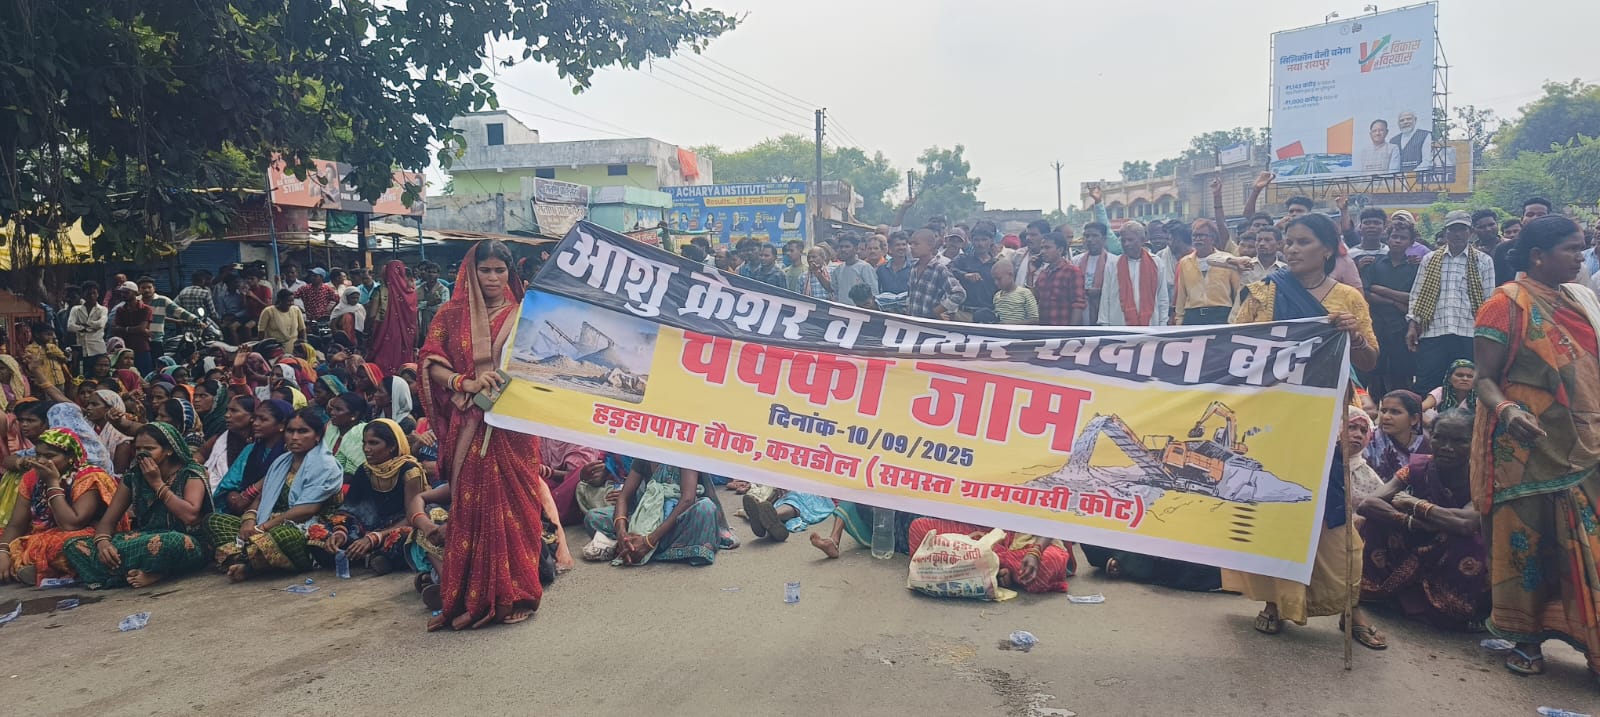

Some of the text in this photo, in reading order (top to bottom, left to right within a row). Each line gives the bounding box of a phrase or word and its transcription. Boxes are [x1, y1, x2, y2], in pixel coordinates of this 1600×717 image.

[1287, 59, 1330, 72] नया रायपुर
[676, 186, 720, 197] ACHARYA
[721, 184, 766, 196] INSTITUTE
[557, 227, 1323, 386] आशु क्रेशर व पत्थर खदान बंद
[682, 330, 1092, 452] चक्का जाम
[592, 403, 699, 444] हड़हापारा
[865, 455, 955, 495] (समस्त
[960, 479, 1073, 512] ग्रामवासी
[1077, 488, 1145, 529] कोट)
